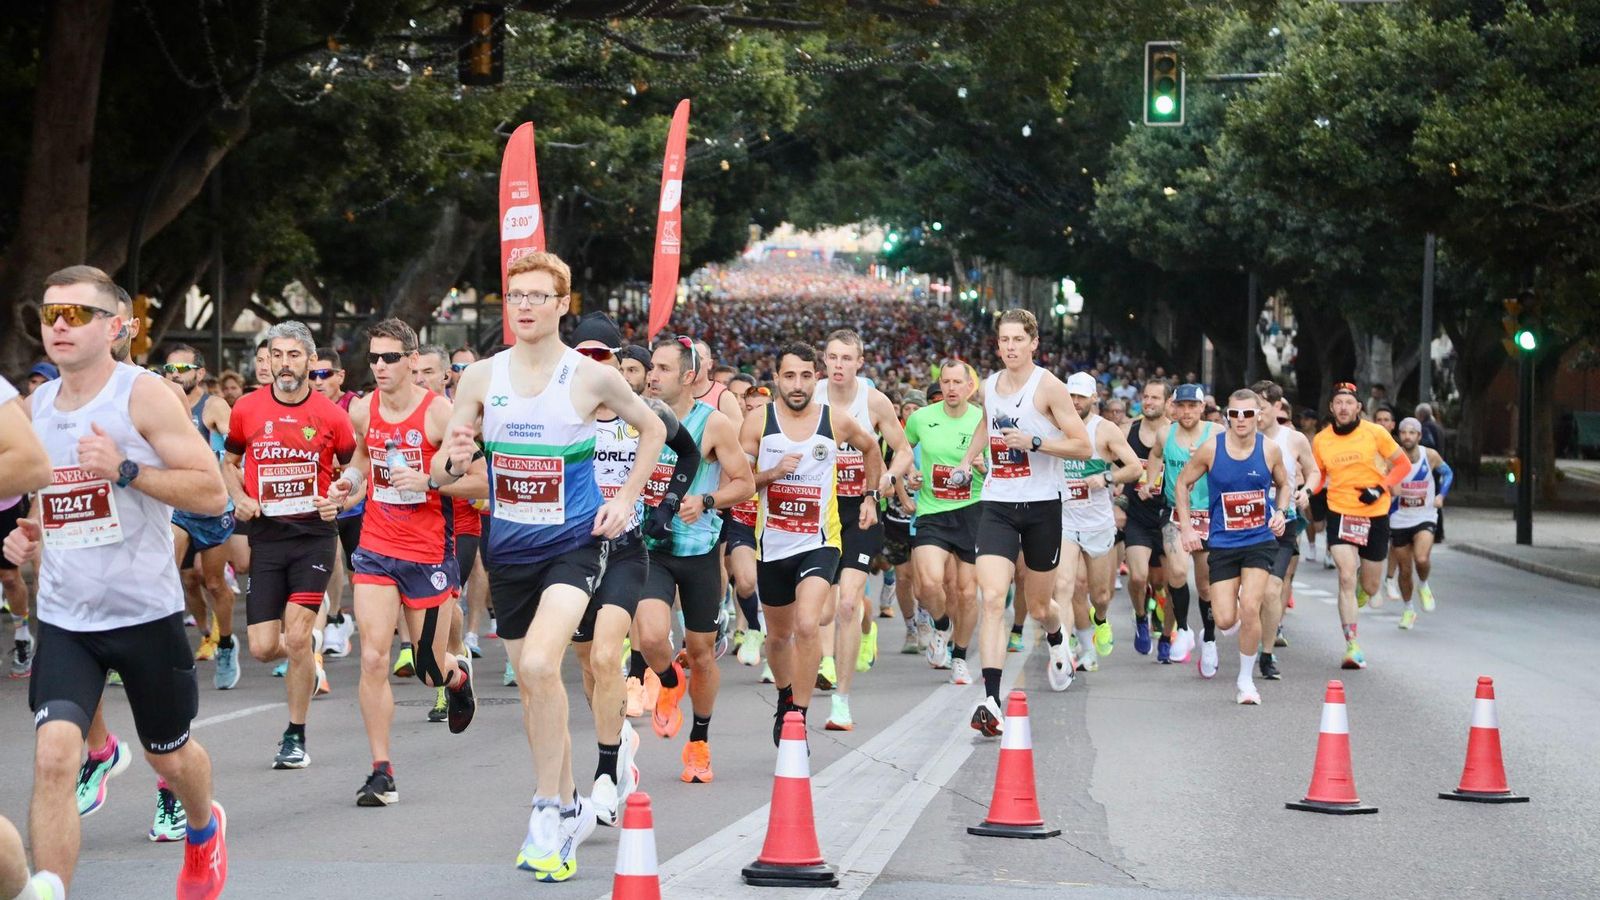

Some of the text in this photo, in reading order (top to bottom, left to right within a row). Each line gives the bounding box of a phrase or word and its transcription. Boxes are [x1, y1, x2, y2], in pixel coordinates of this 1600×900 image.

[511, 216, 528, 228] 3:00
[506, 422, 544, 432] clapham
[509, 429, 542, 438] chasers
[274, 465, 312, 475] GENERALI
[508, 459, 557, 471] GENERALI
[271, 481, 305, 494] 15278
[505, 479, 547, 495] 14827
[780, 486, 819, 496] GENERALI
[49, 494, 93, 513] 12247
[779, 501, 807, 512] 4210
[1235, 504, 1255, 514] 5791
[151, 730, 190, 751] FUSION
